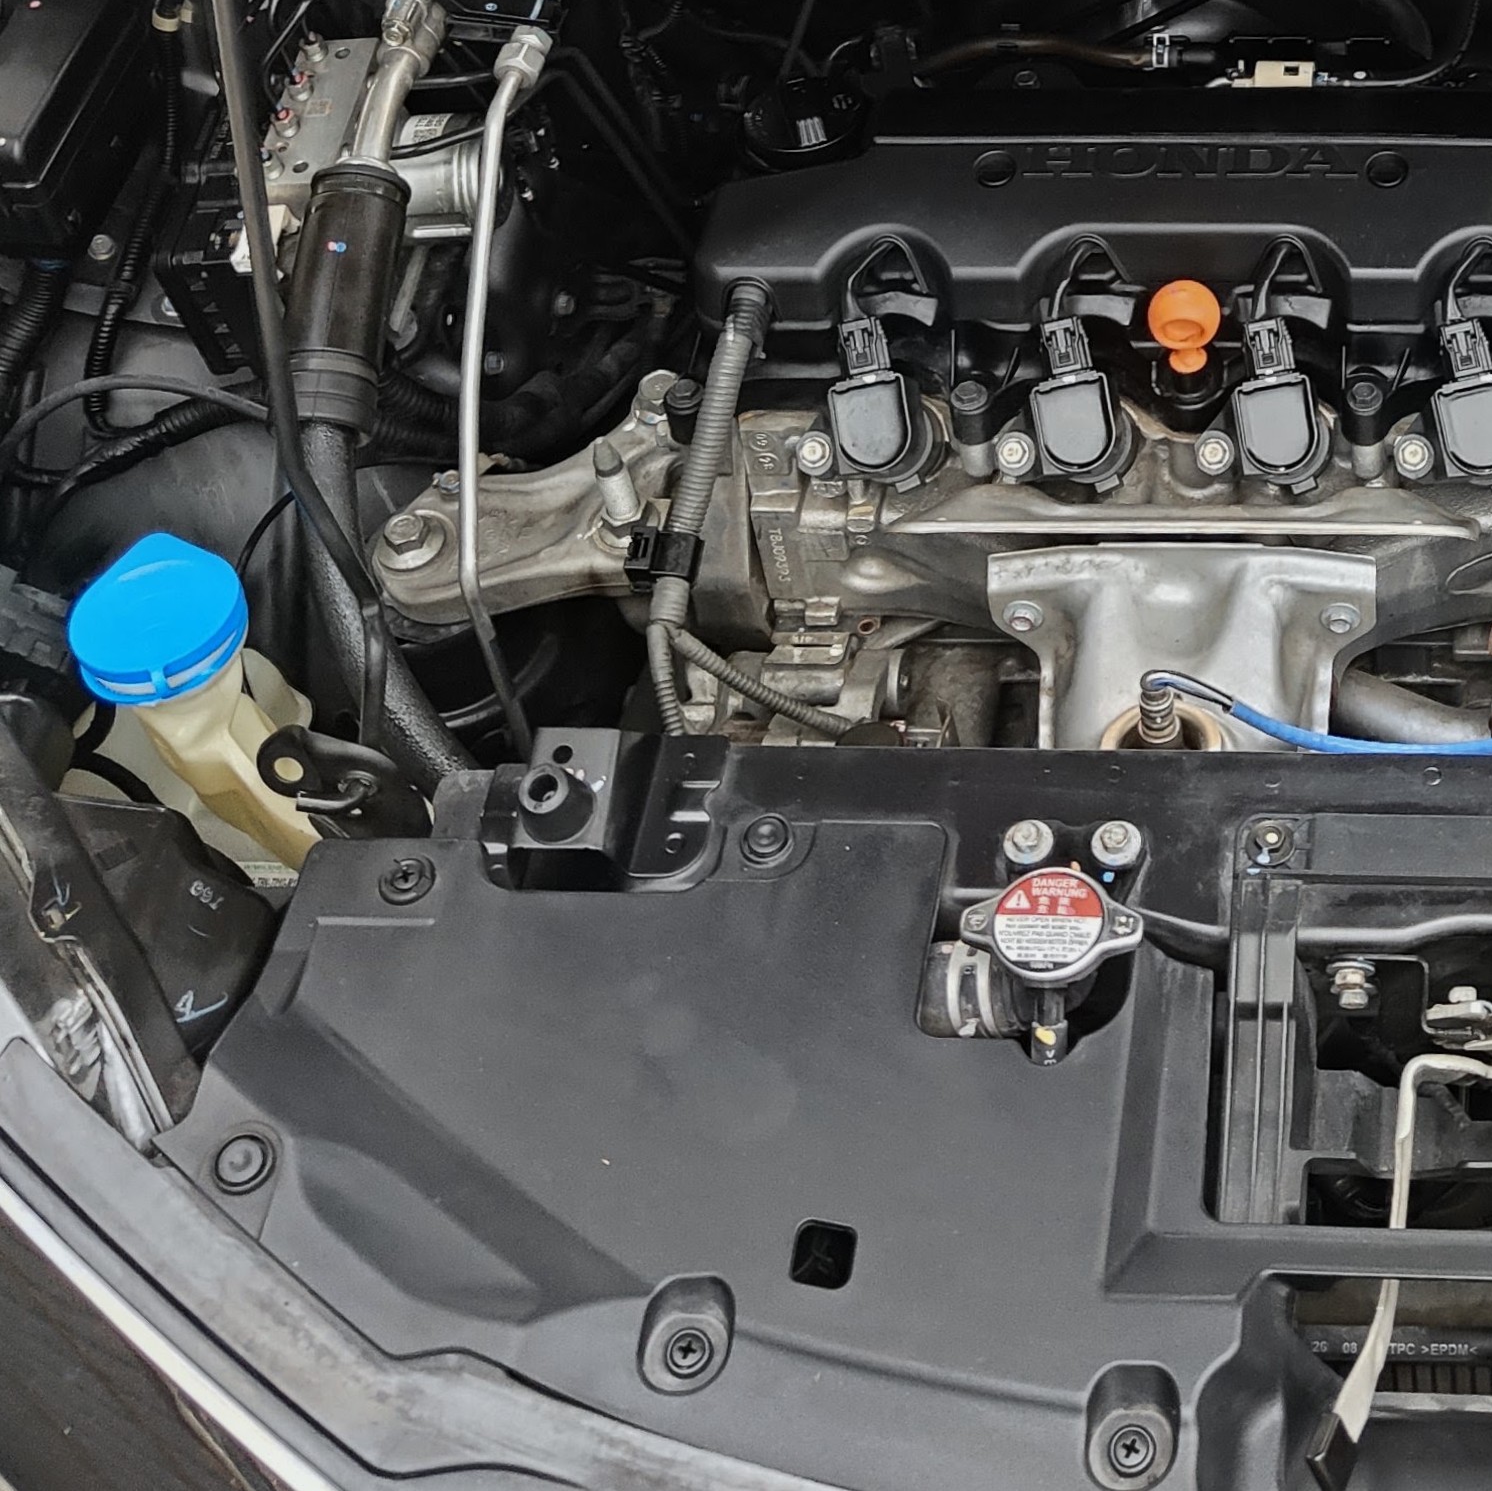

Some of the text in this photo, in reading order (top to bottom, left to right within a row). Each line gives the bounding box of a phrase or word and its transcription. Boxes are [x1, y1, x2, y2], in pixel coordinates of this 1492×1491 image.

[1022, 146, 1360, 178] HONDA
[1032, 877, 1079, 888] DANGER
[1421, 1344, 1478, 1356] >EPDM<
